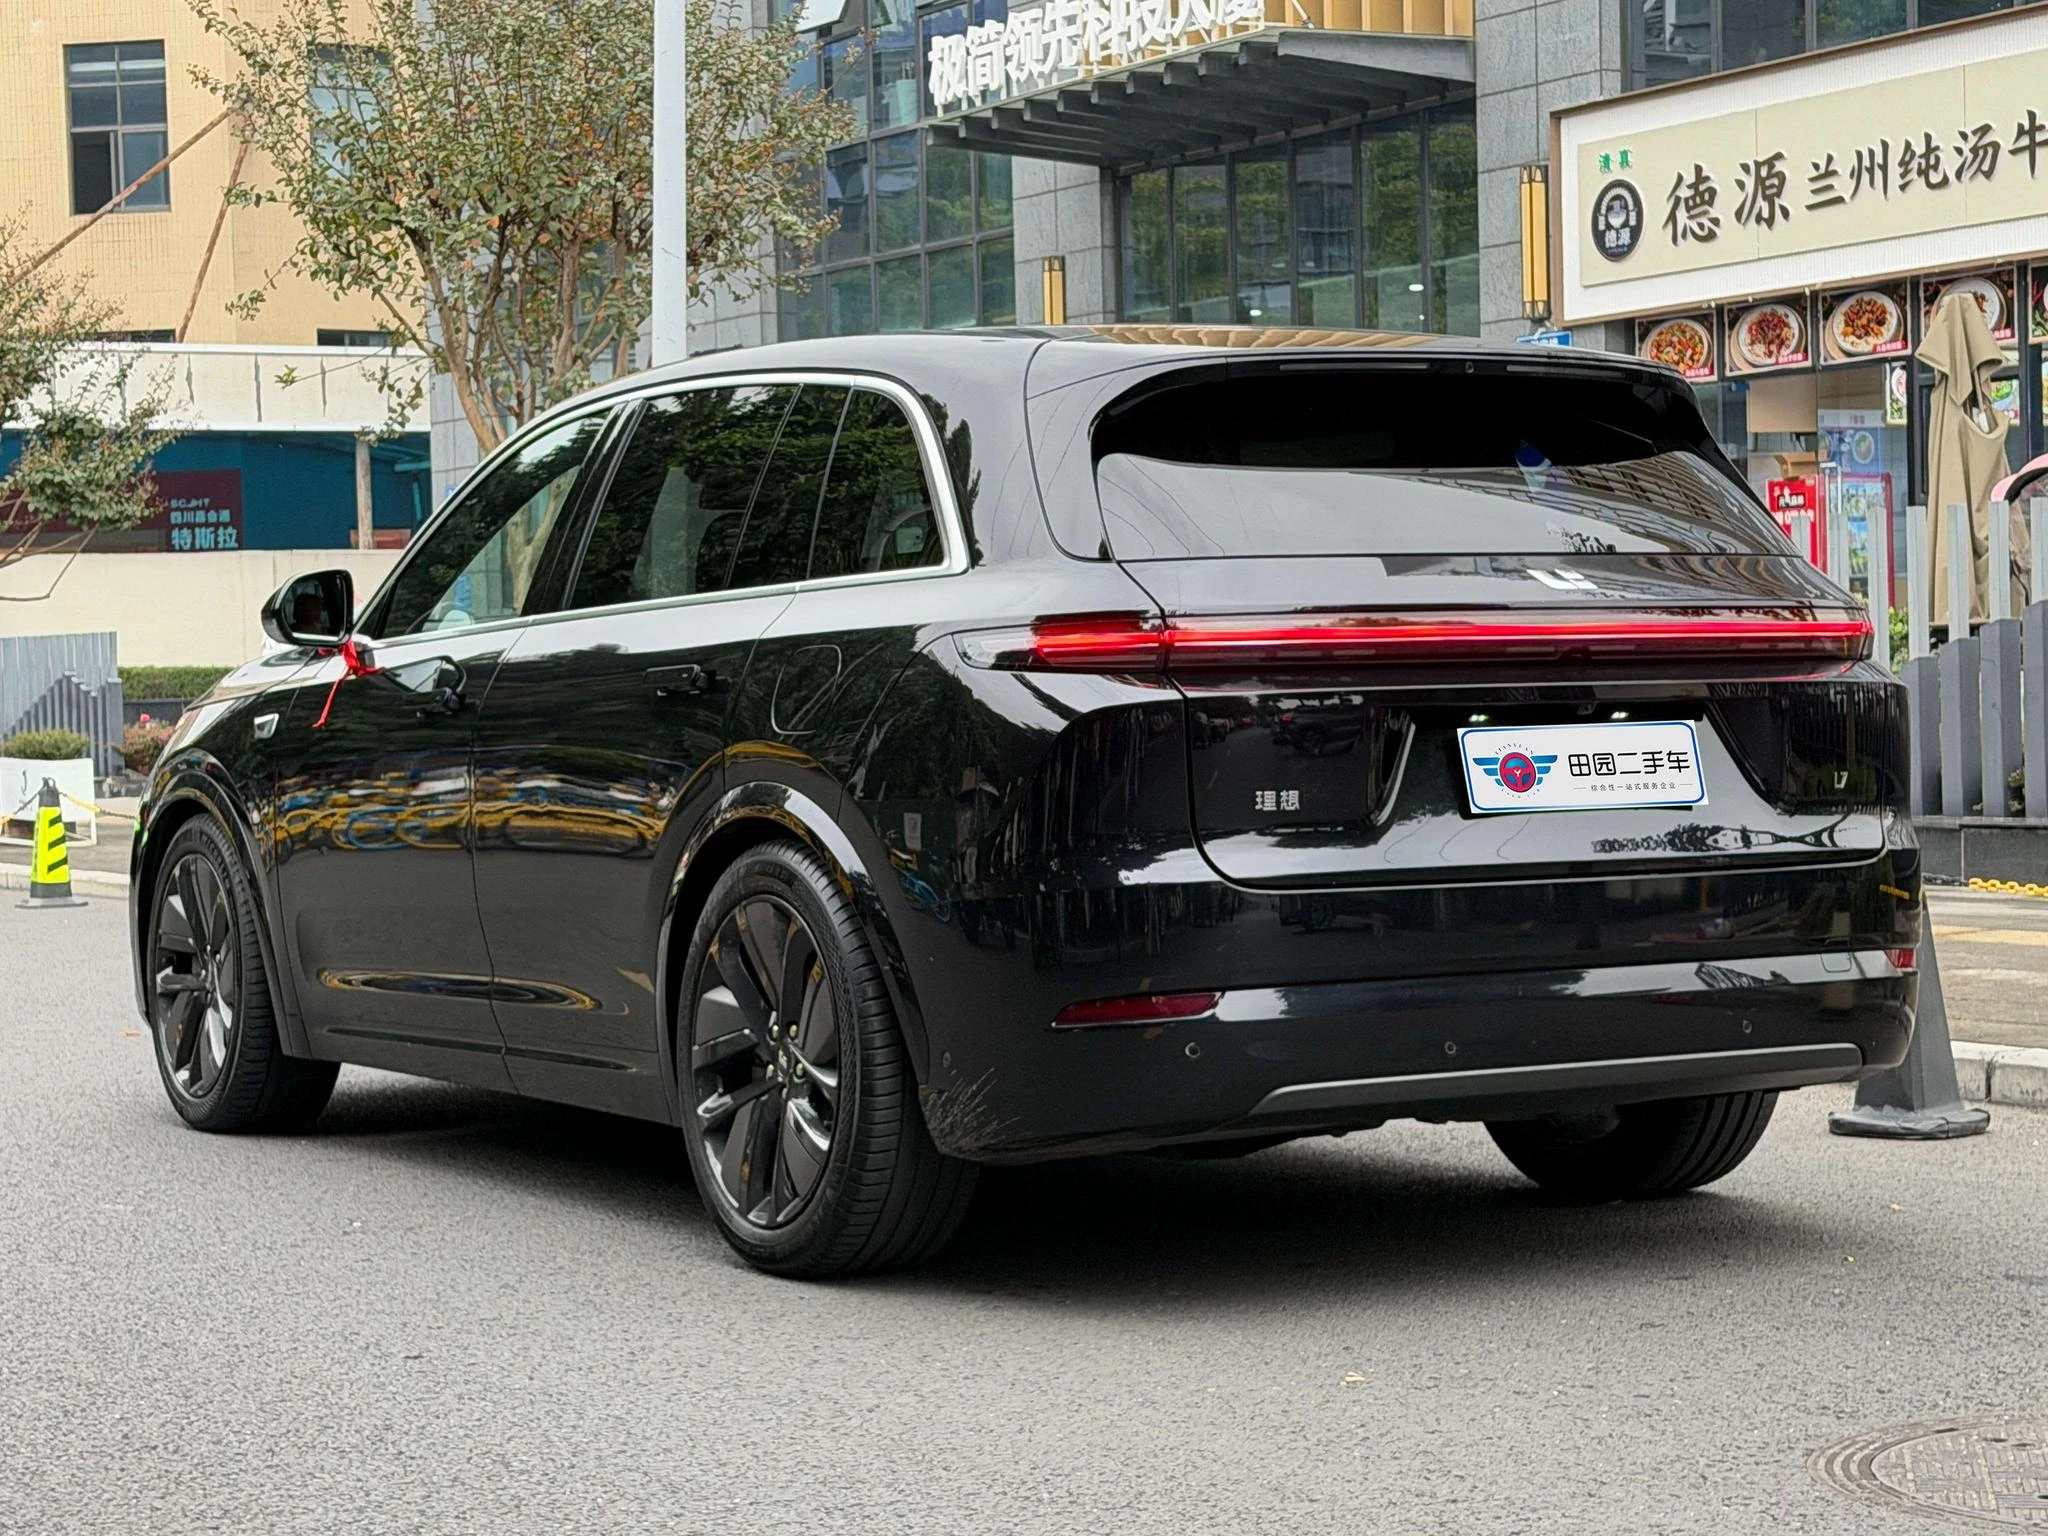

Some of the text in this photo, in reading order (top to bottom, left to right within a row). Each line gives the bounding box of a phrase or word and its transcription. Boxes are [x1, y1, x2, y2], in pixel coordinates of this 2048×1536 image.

[171, 527, 239, 550] 特斯拉
[1255, 790, 1300, 811] 理想
